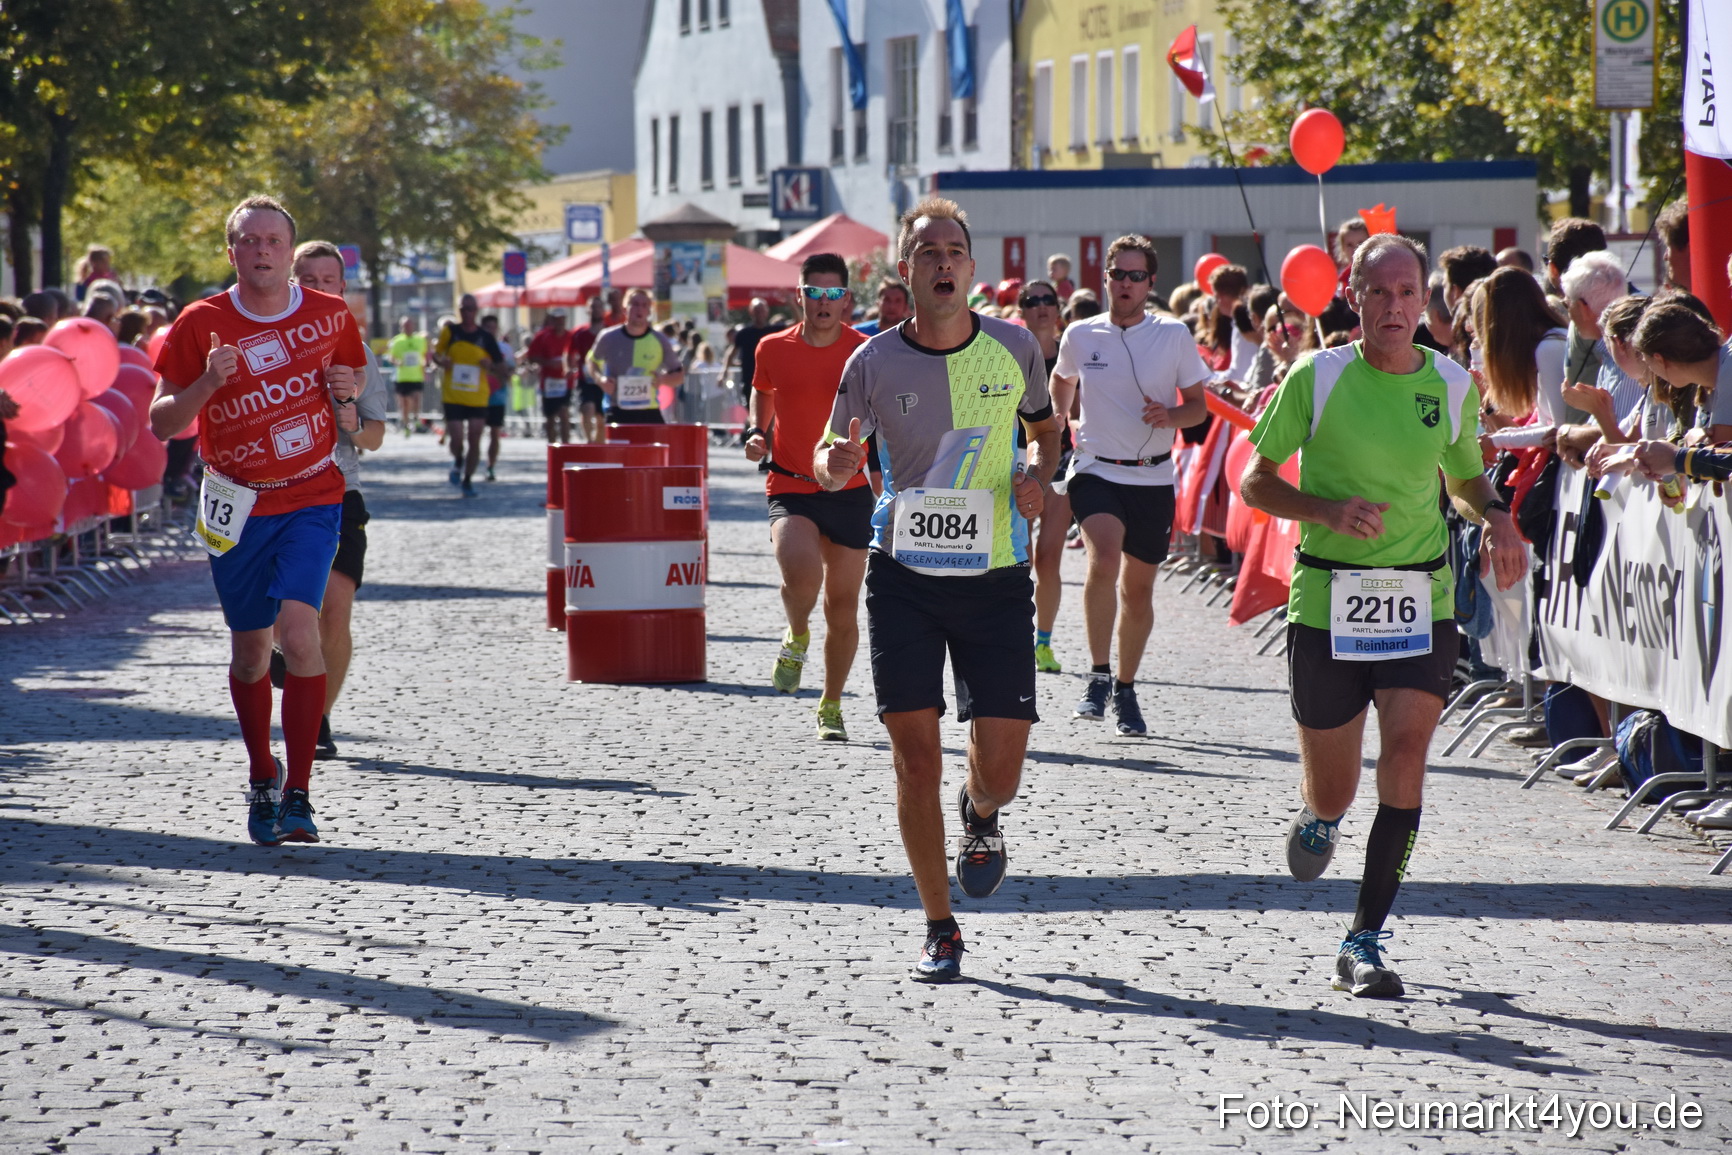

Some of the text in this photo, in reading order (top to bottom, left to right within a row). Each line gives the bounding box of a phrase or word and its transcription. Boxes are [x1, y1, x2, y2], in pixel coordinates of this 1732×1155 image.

[1613, 6, 1637, 32] H
[241, 332, 277, 348] raumbox
[296, 341, 332, 360] schenken
[623, 385, 648, 396] 2234
[248, 409, 285, 427] wohnen
[272, 417, 306, 434] raumbox
[207, 479, 236, 499] BOCK
[247, 480, 288, 490] Helsana
[924, 495, 967, 506] BOCK
[909, 511, 978, 540] 3084
[914, 541, 964, 551] PARTL Neumarkt
[1361, 578, 1404, 589] BOCK
[1345, 595, 1417, 624] 2216
[1355, 639, 1408, 651] Reinhard
